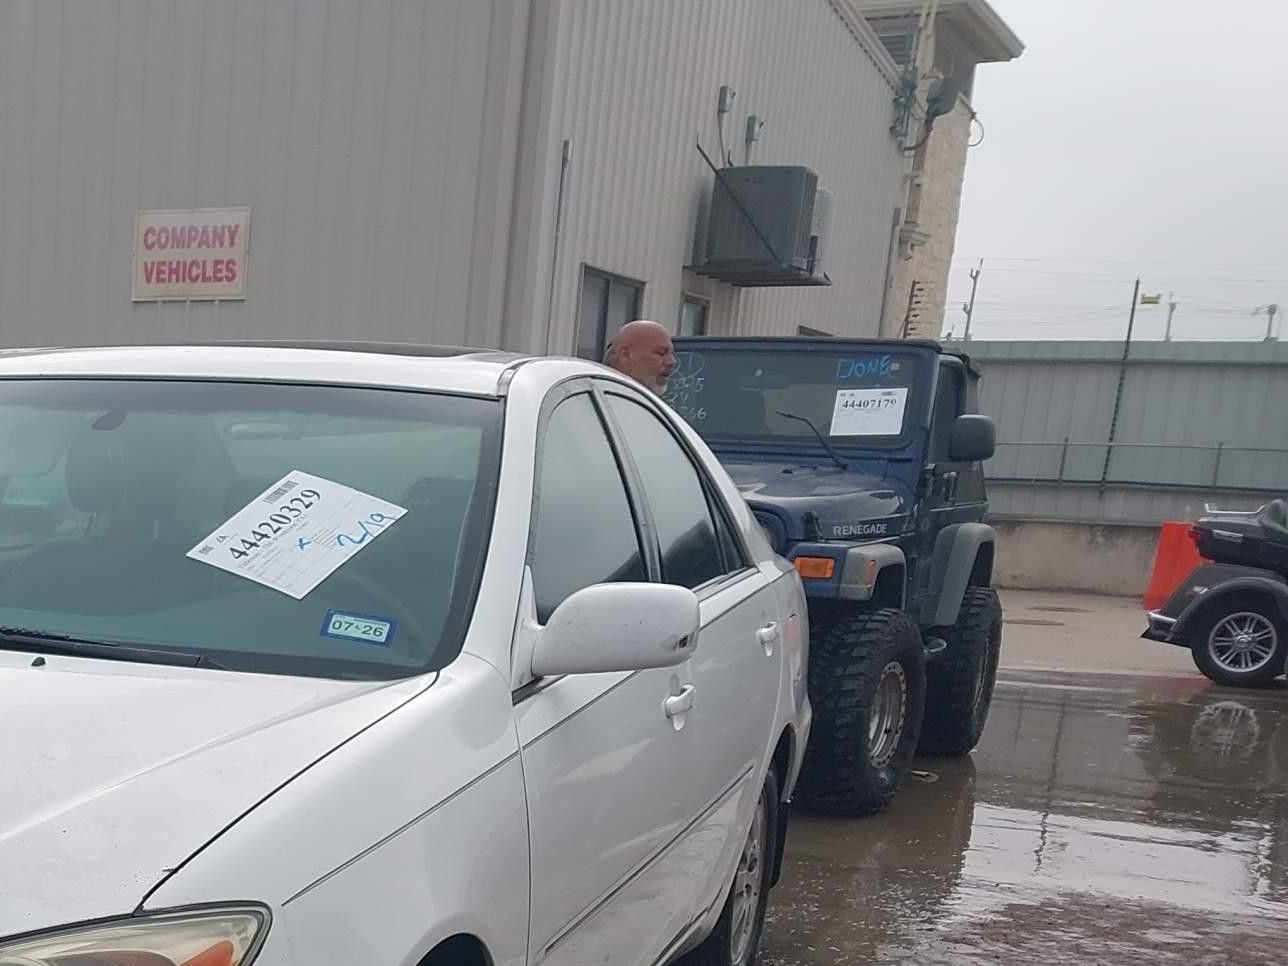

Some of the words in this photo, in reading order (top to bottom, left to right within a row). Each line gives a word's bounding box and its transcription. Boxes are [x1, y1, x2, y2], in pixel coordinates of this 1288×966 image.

[143, 224, 240, 251] COMPANY
[143, 258, 237, 284] VEHICLES
[841, 398, 897, 409] 44407179
[229, 488, 321, 560] 44420329
[833, 523, 887, 536] RENEGADE
